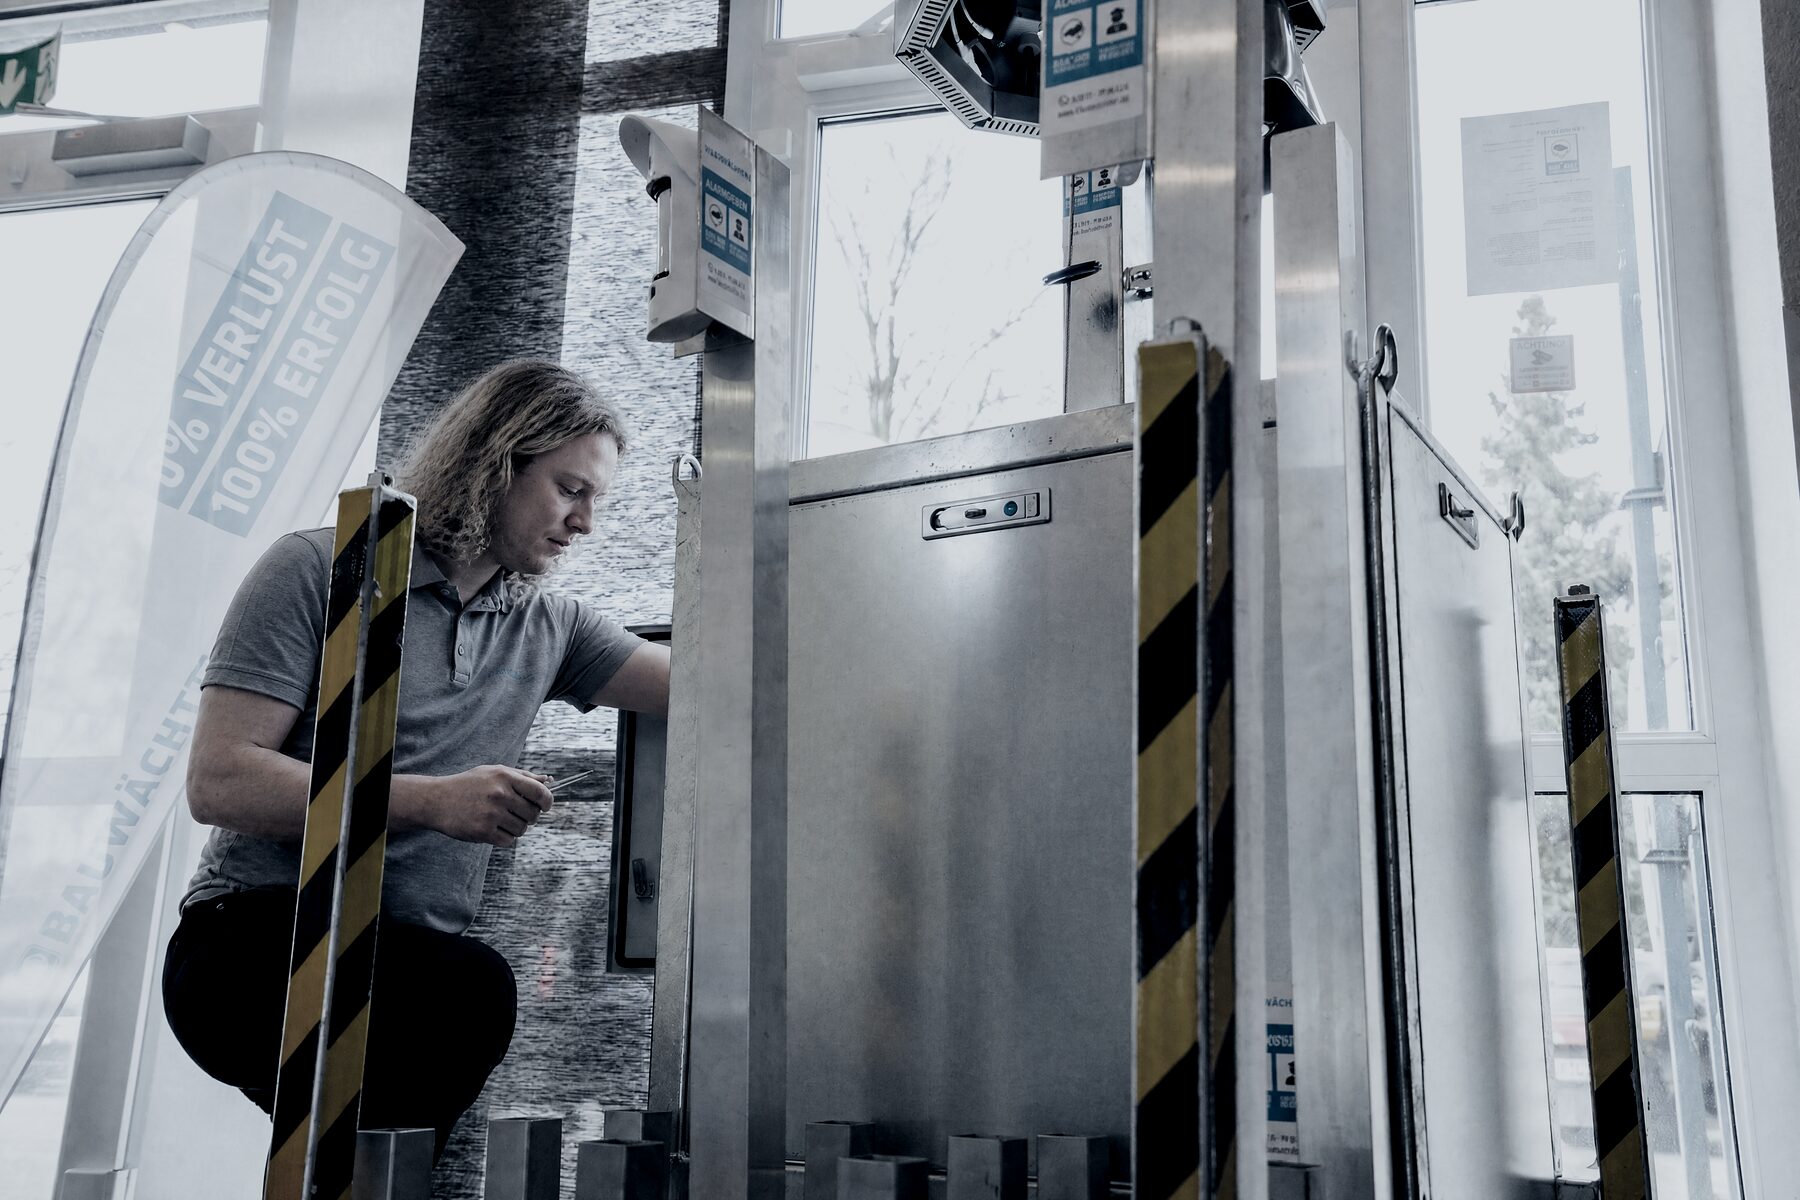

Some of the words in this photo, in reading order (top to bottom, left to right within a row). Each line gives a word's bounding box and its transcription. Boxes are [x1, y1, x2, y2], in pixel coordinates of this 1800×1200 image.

[183, 219, 308, 408] VERLUST
[212, 408, 299, 515] 100%
[273, 235, 381, 399] ERFOLG
